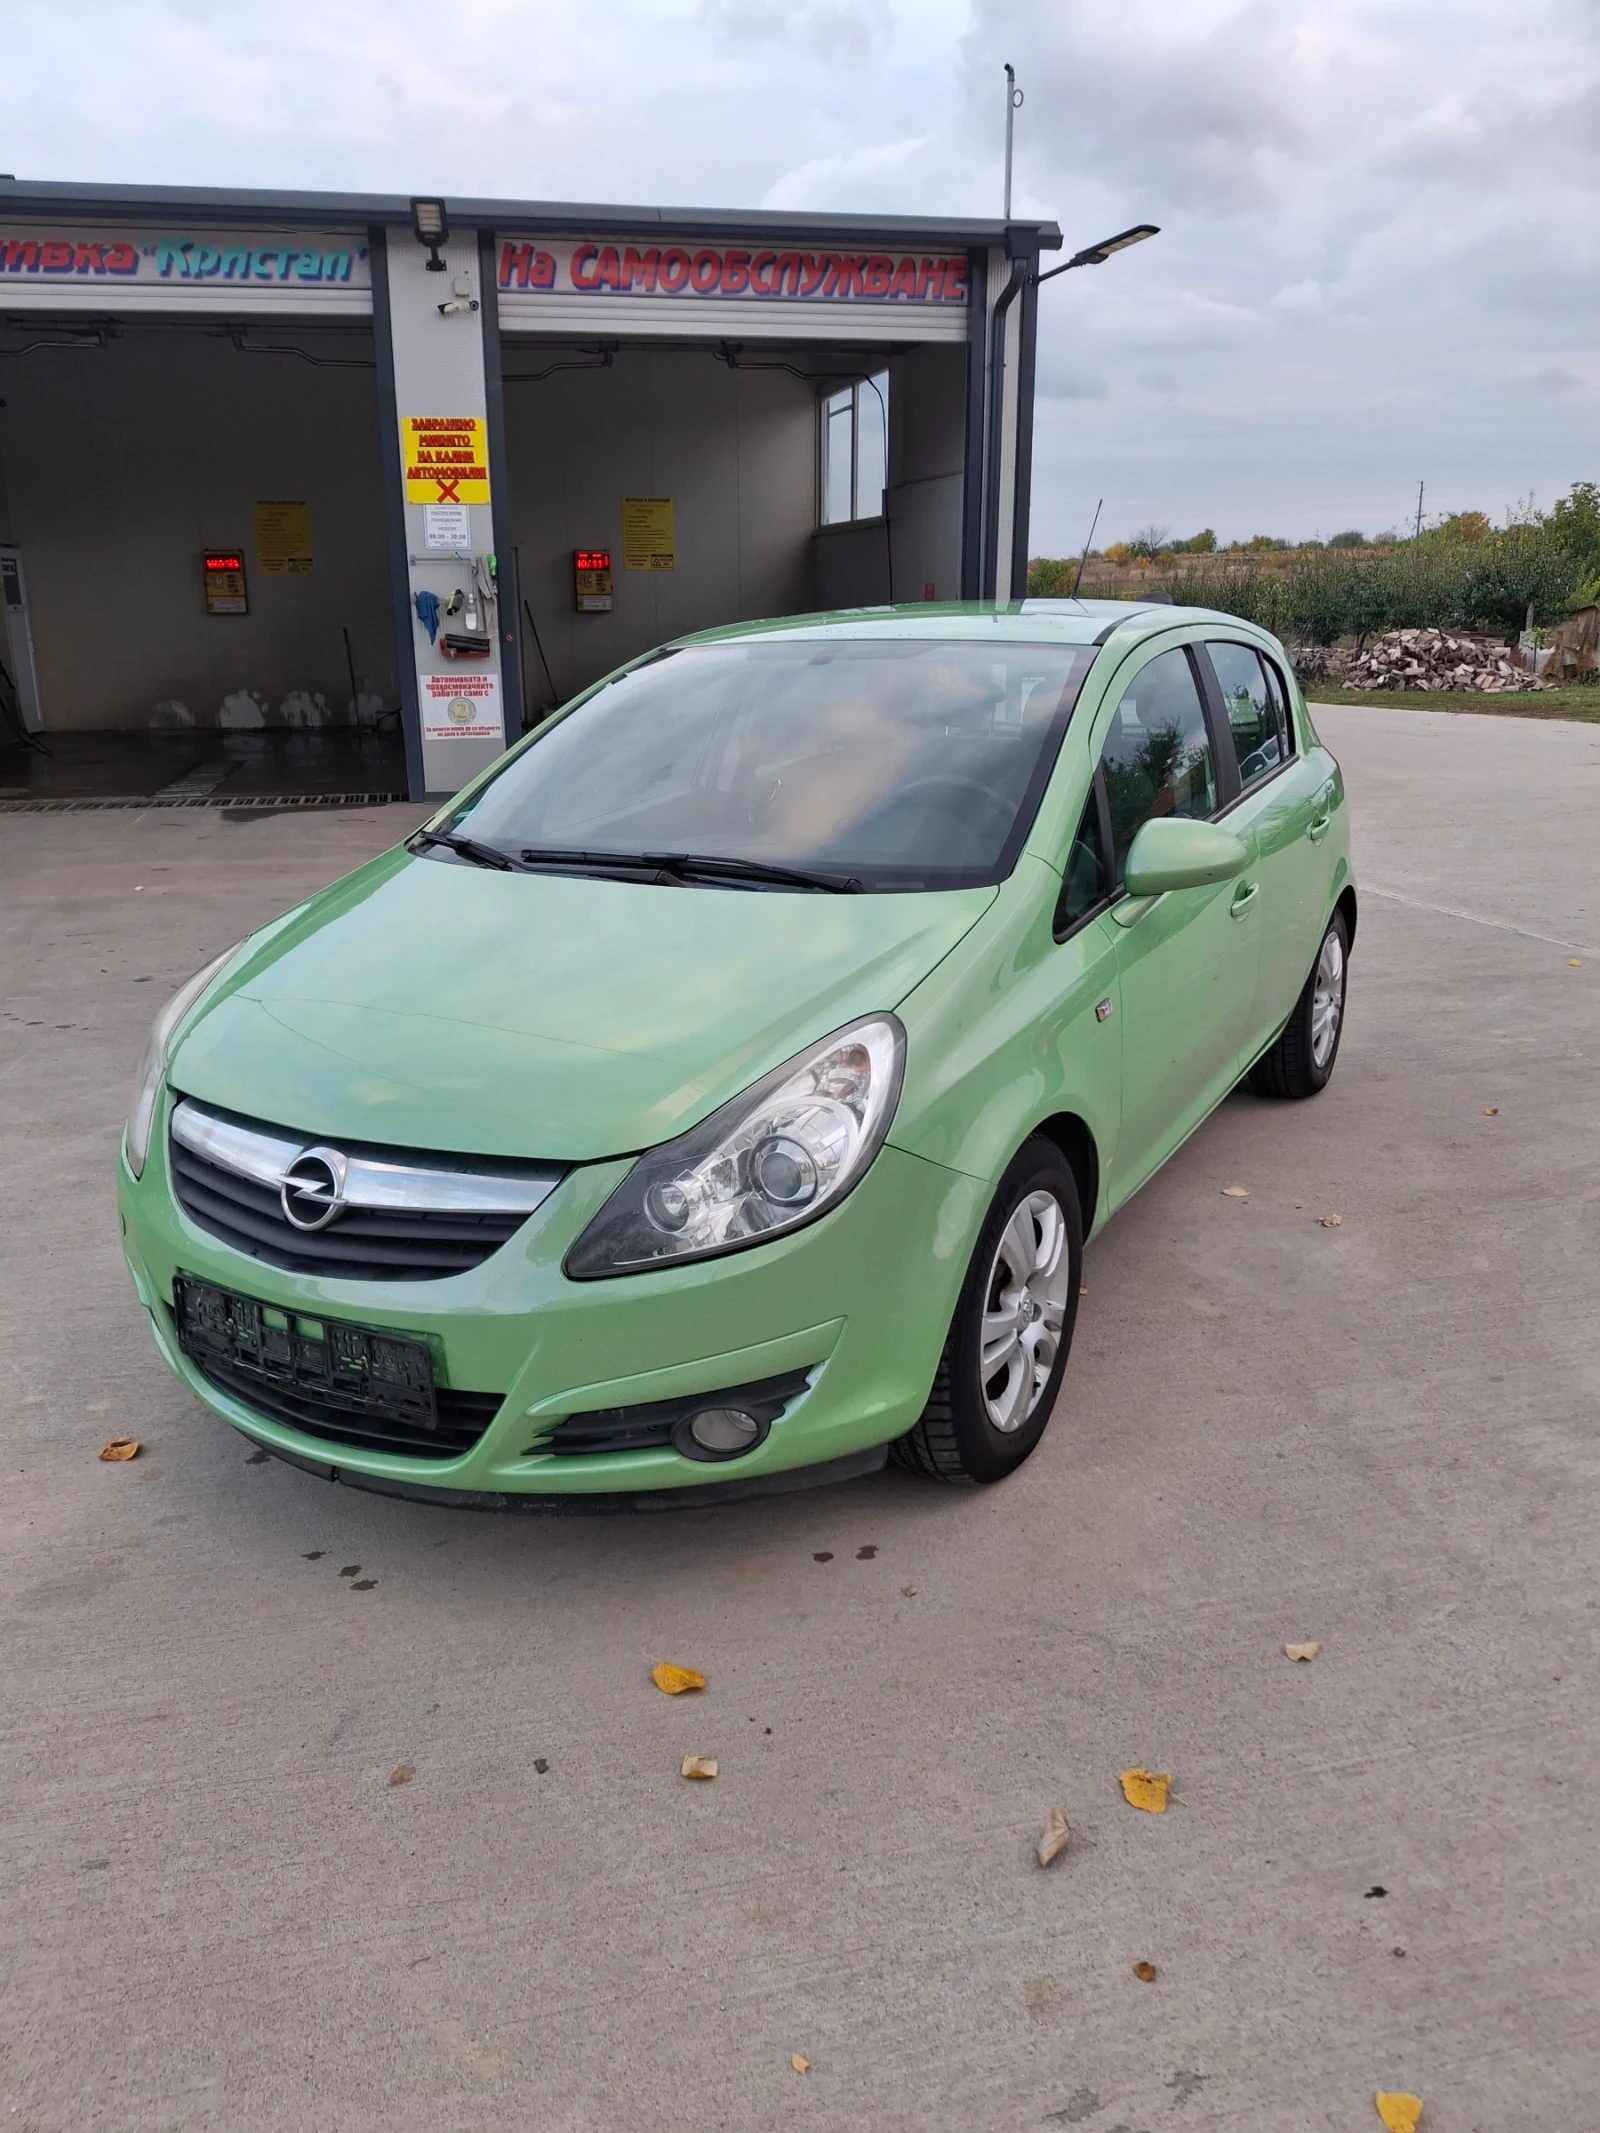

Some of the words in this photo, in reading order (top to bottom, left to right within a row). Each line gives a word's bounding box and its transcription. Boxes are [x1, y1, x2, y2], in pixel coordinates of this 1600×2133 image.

[0, 240, 139, 276] ивка
[498, 241, 557, 288] На
[569, 244, 968, 302] САМООБСЛУЖВАНЕ
[411, 418, 476, 431] ЗАБРАНЕНО
[419, 434, 471, 447] МИЕНЕТО
[417, 450, 433, 463] НА
[435, 450, 475, 463] КАЛНИ
[407, 466, 487, 479] АВТОМОБИЛИ
[431, 675, 481, 683] Автомивката
[426, 683, 494, 691] прахосмокачките
[432, 690, 462, 698] работят
